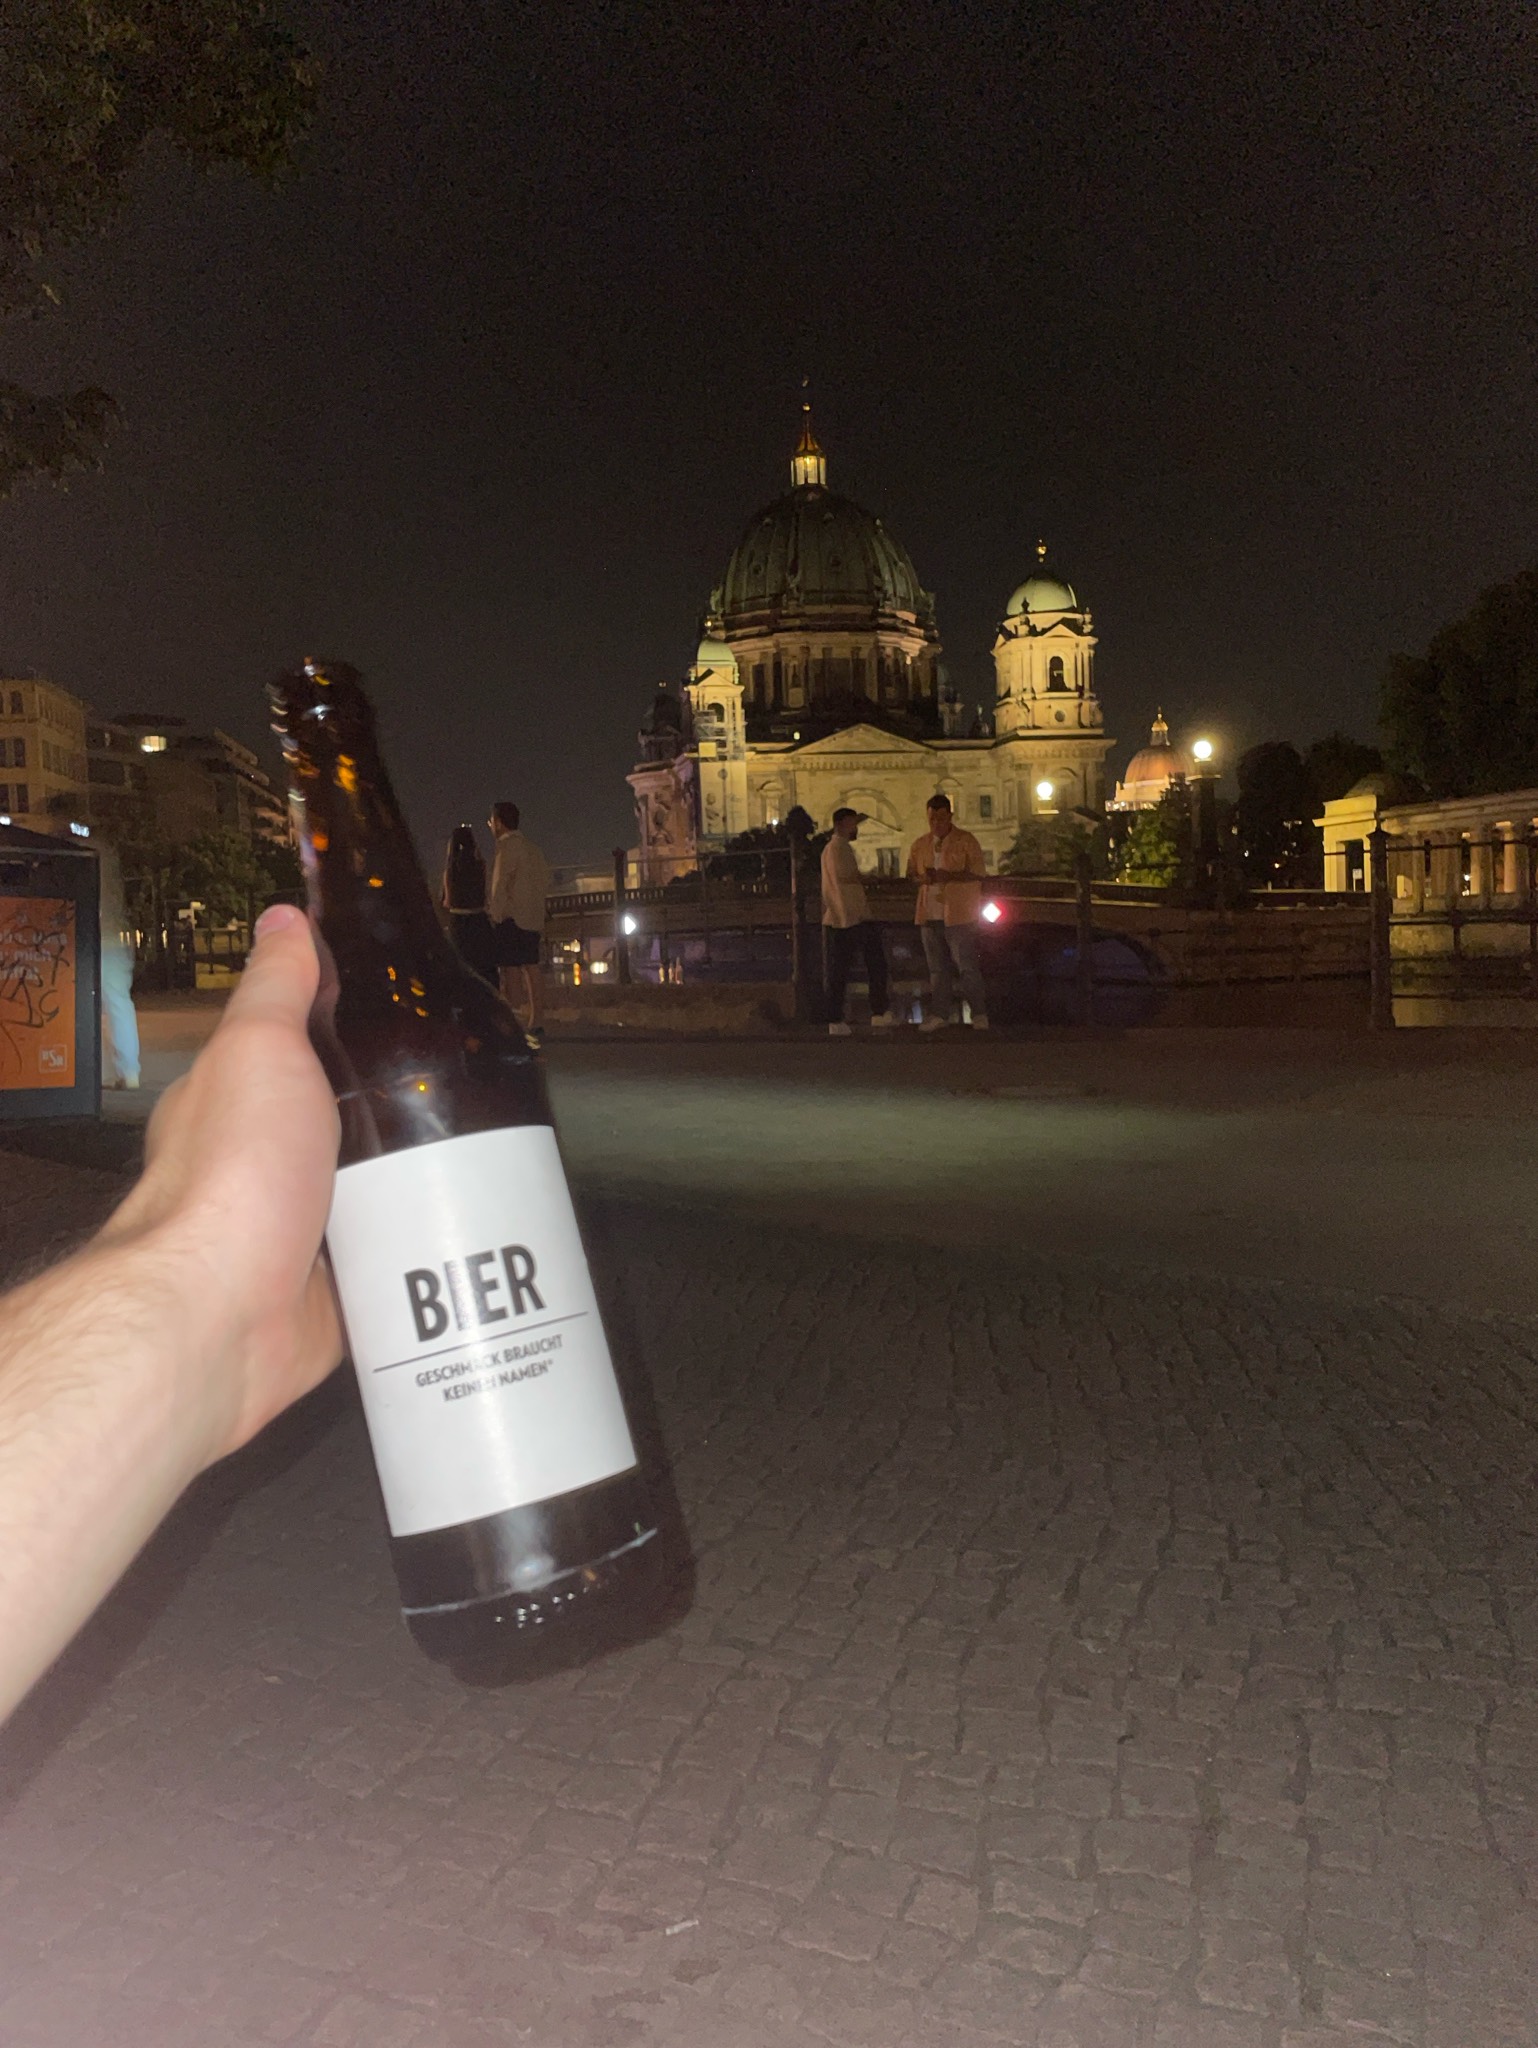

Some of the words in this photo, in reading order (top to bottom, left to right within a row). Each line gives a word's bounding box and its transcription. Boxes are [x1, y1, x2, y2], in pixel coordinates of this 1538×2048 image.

[404, 1243, 547, 1343] BIER
[415, 1351, 502, 1388] GESCHMCK
[503, 1334, 562, 1363] BRAUCHT
